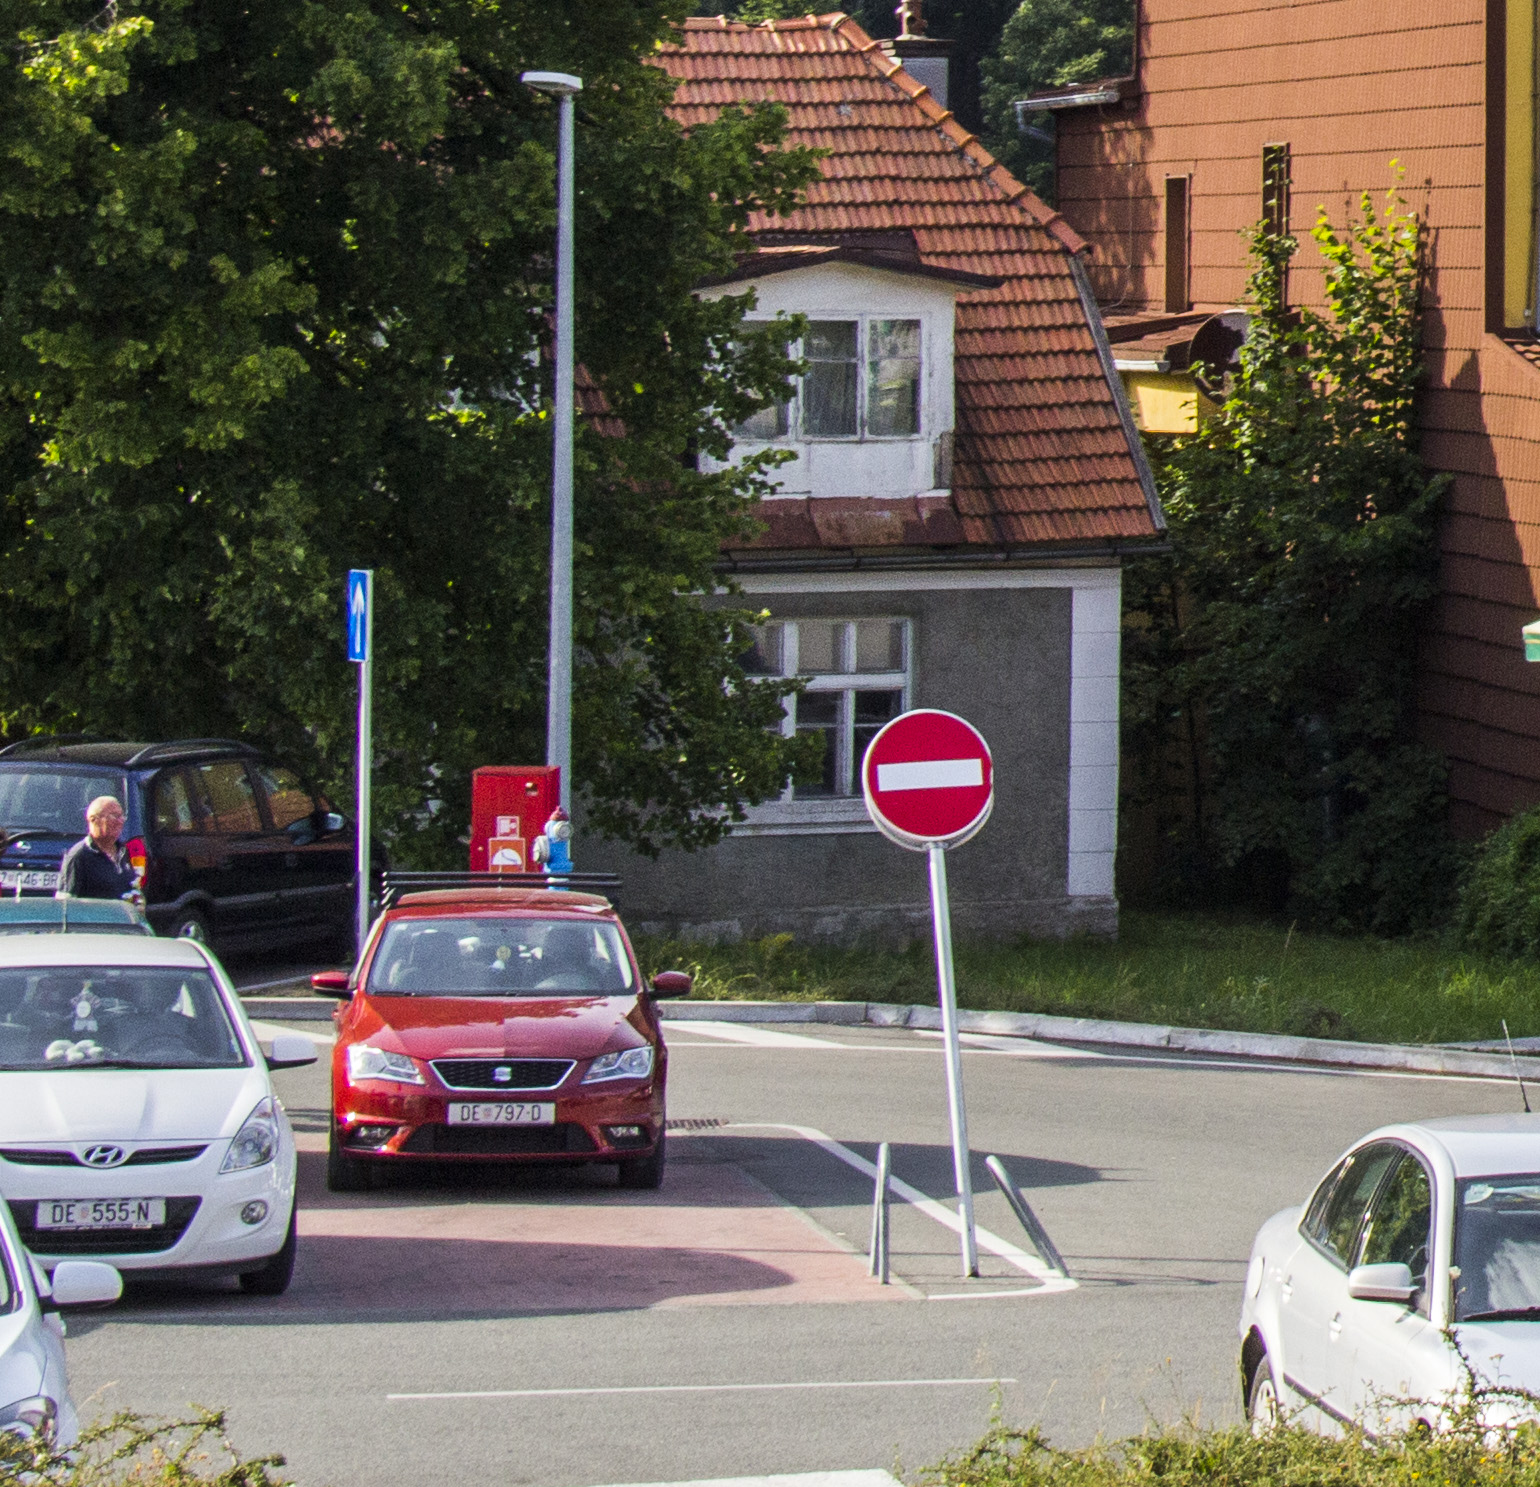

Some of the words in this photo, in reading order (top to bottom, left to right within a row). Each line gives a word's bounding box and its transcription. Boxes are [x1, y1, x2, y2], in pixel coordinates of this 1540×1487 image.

[461, 1105, 480, 1121] DE
[51, 1204, 75, 1223] DE
[92, 1202, 149, 1223] 555-N
